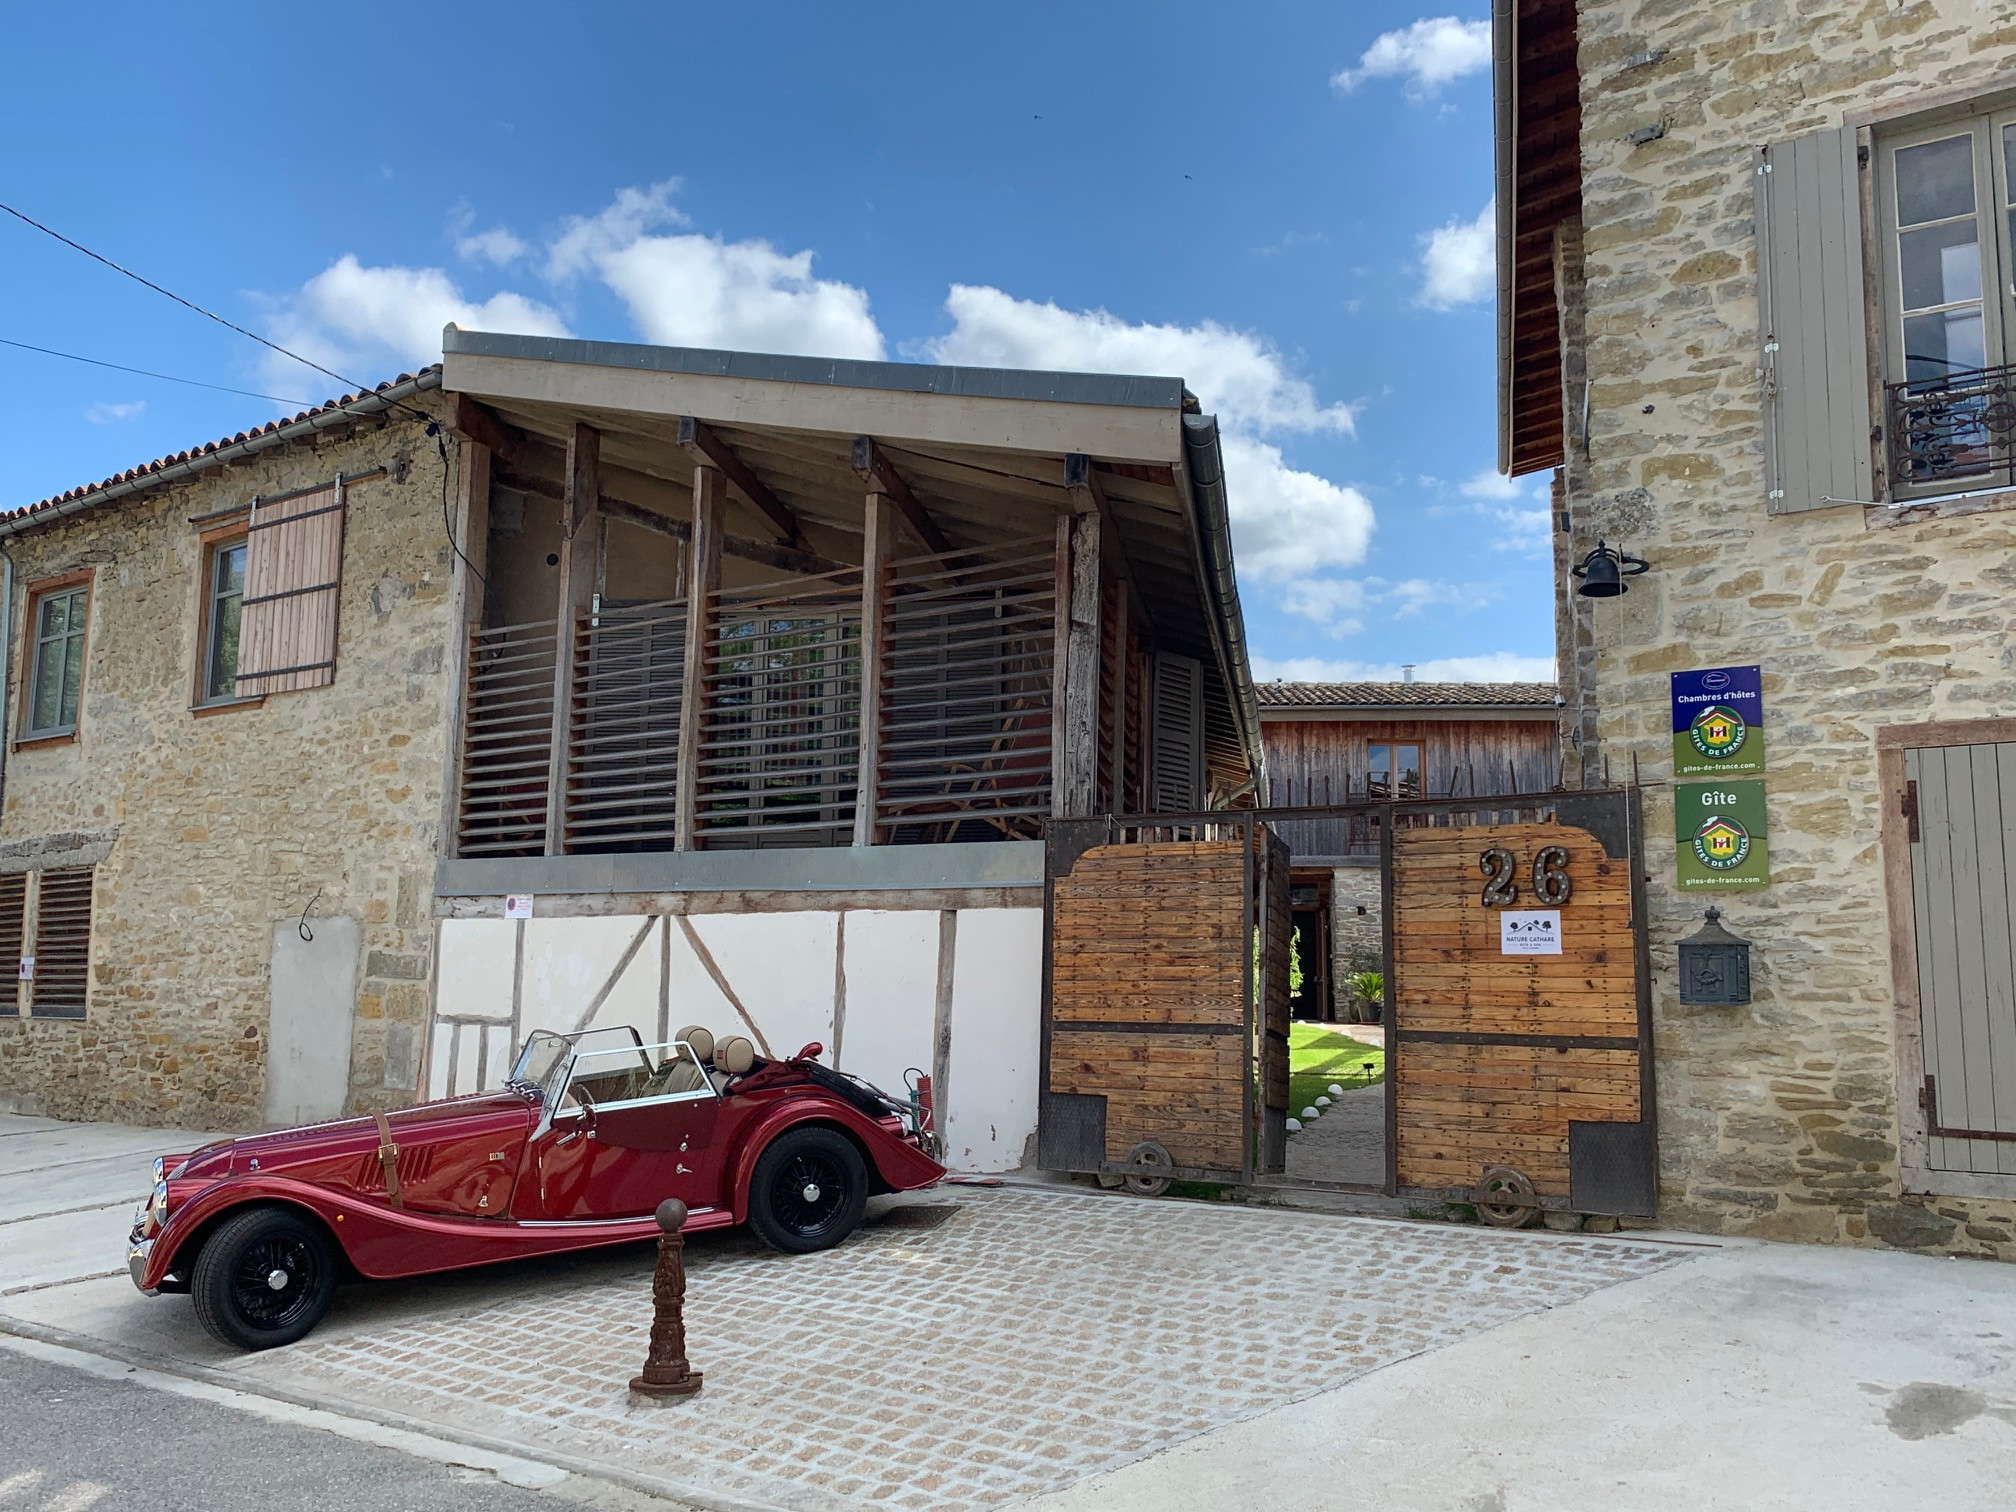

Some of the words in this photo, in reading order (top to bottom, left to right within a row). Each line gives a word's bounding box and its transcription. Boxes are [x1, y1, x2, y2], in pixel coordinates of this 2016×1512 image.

[1678, 693, 1722, 703] Chambres
[1723, 690, 1756, 700] d'hôtes
[1708, 748, 1720, 756] DE
[1723, 725, 1744, 754] FRANCE
[1683, 762, 1756, 774] gites-de-france.com
[1701, 790, 1737, 806] Gîte
[1711, 860, 1724, 868] DE
[1726, 836, 1748, 867] FRANCE
[1480, 846, 1573, 907] 26
[1685, 876, 1760, 886] gites-de-france.com
